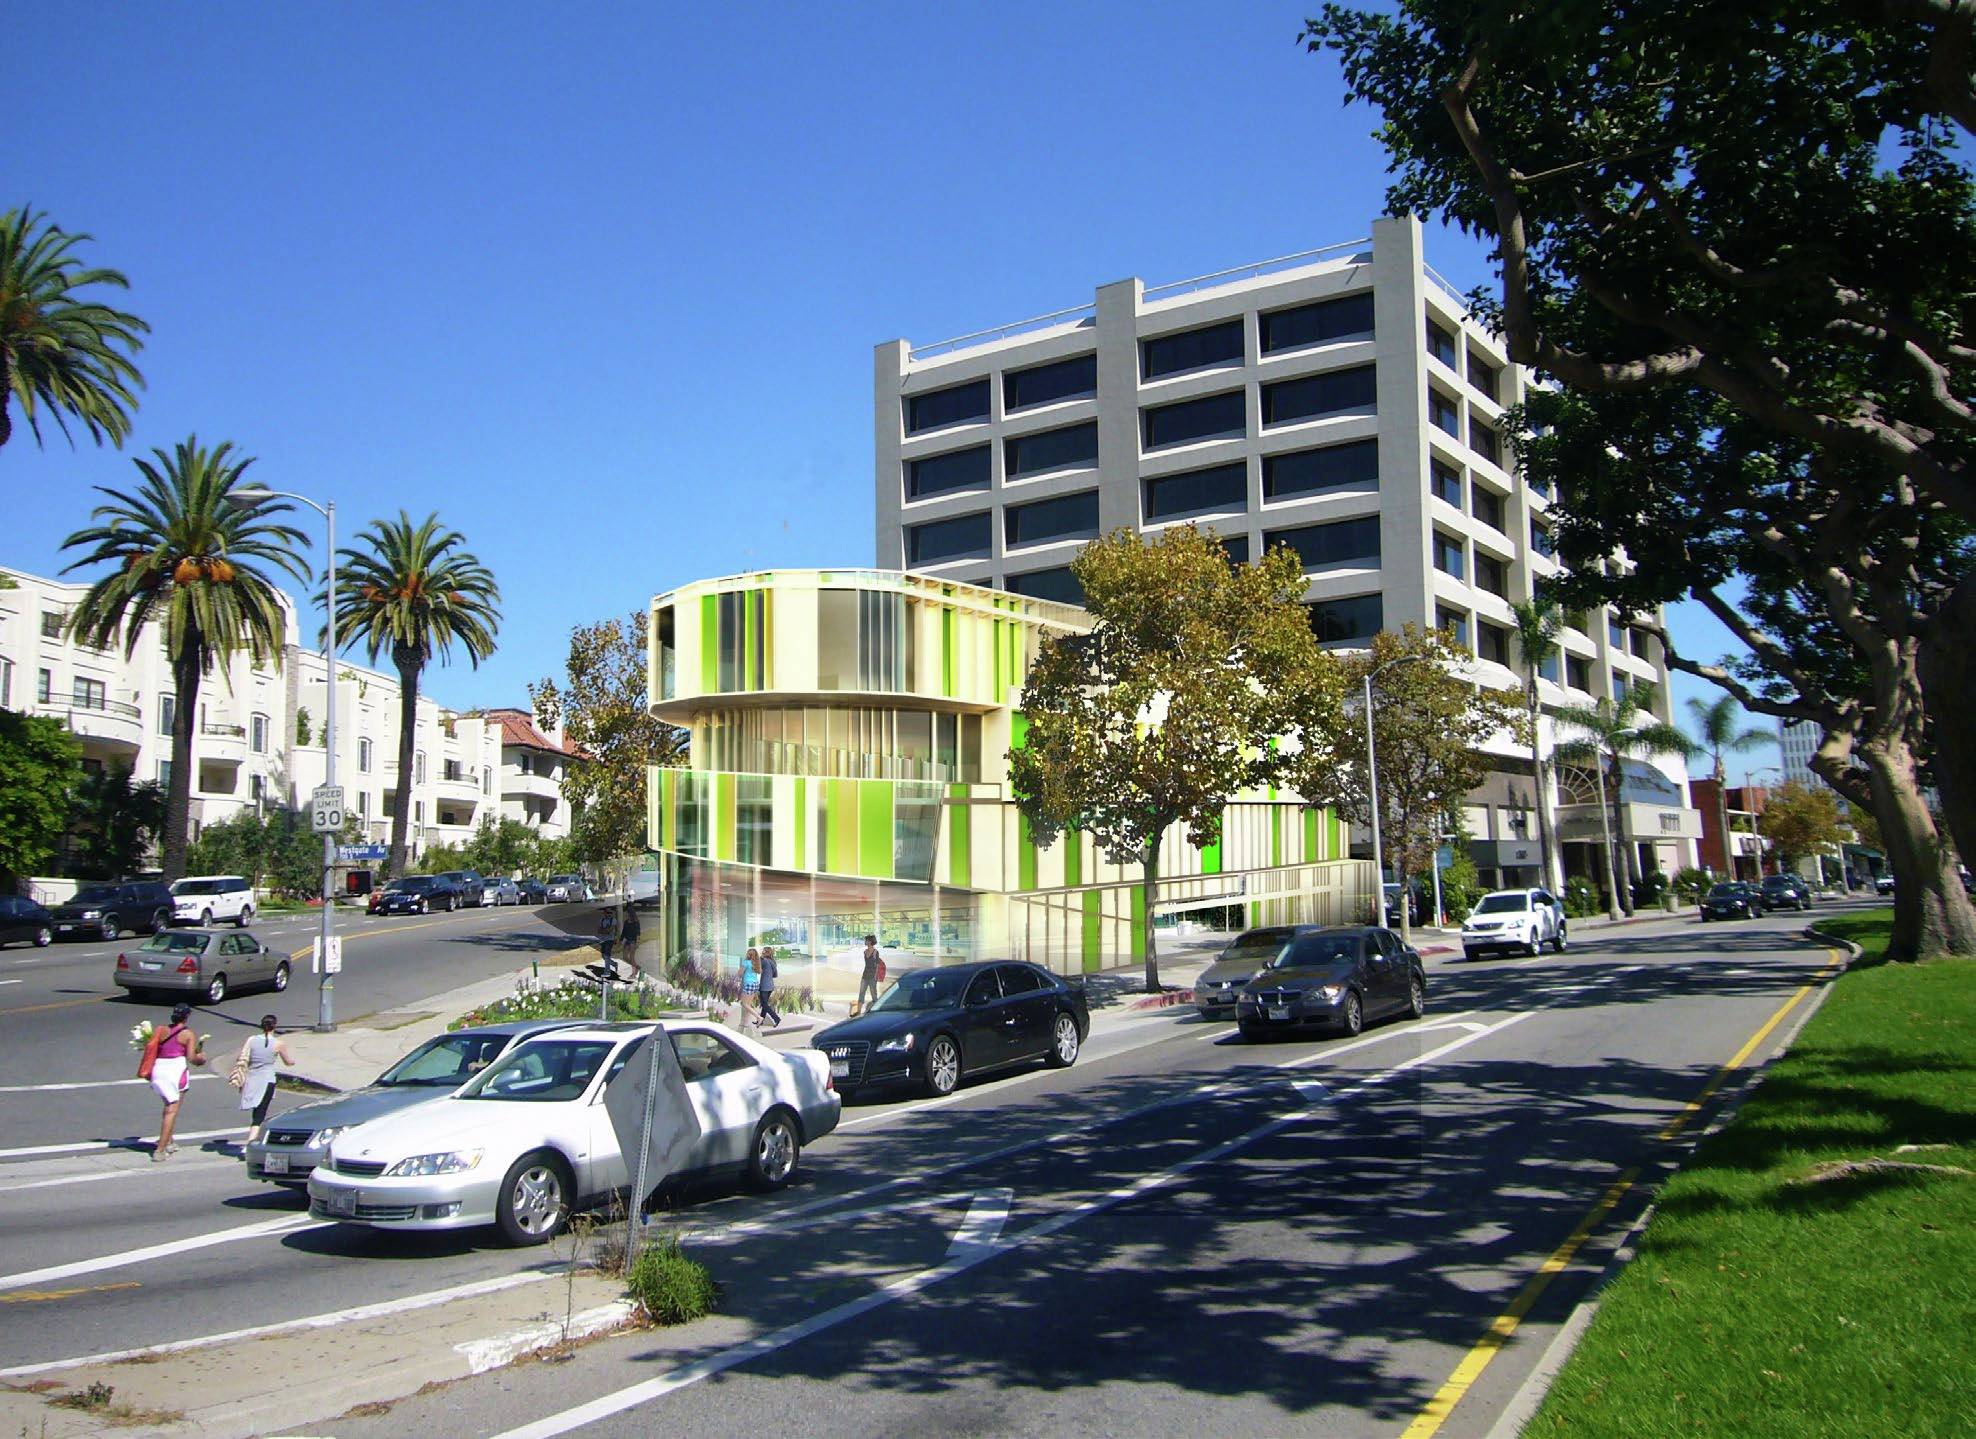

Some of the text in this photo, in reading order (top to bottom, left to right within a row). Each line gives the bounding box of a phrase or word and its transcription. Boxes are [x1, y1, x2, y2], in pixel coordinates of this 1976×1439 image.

[315, 790, 341, 799] SPEED
[317, 800, 339, 808] LIMIT
[316, 811, 340, 826] 30
[339, 847, 369, 856] Westgate
